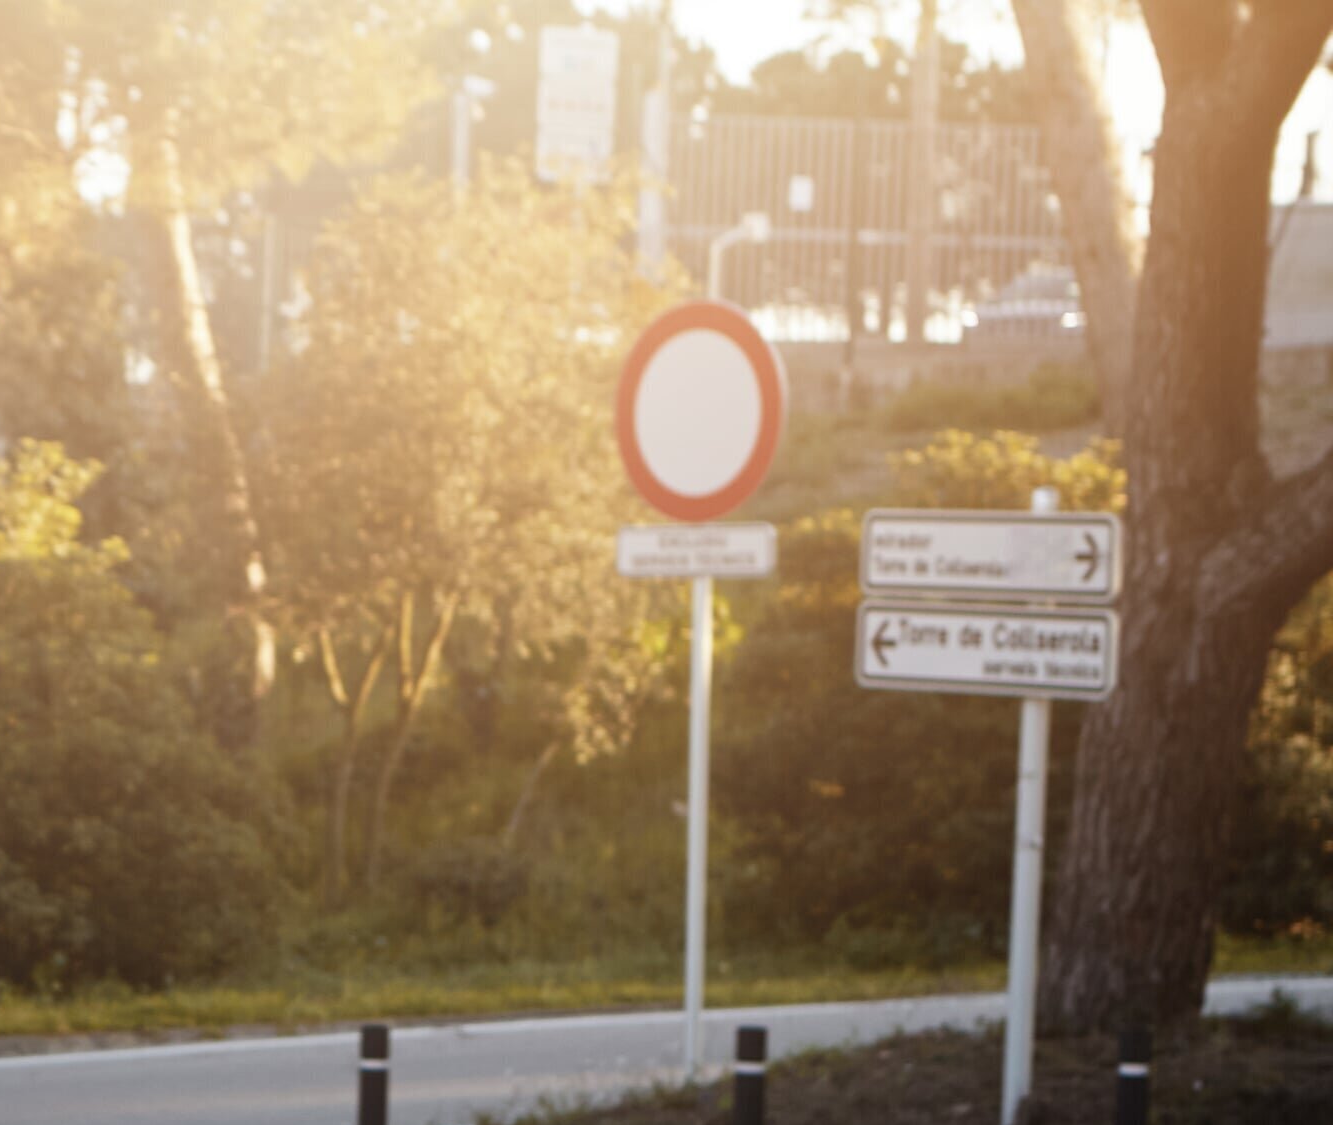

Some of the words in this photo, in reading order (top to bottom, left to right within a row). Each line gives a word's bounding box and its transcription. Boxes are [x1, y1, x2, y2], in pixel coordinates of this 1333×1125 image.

[873, 554, 908, 576] Torre
[913, 557, 931, 576] de
[935, 554, 1010, 580] Collserola
[898, 617, 949, 649] Torre
[958, 621, 984, 651] de
[992, 621, 1102, 656] Collserola
